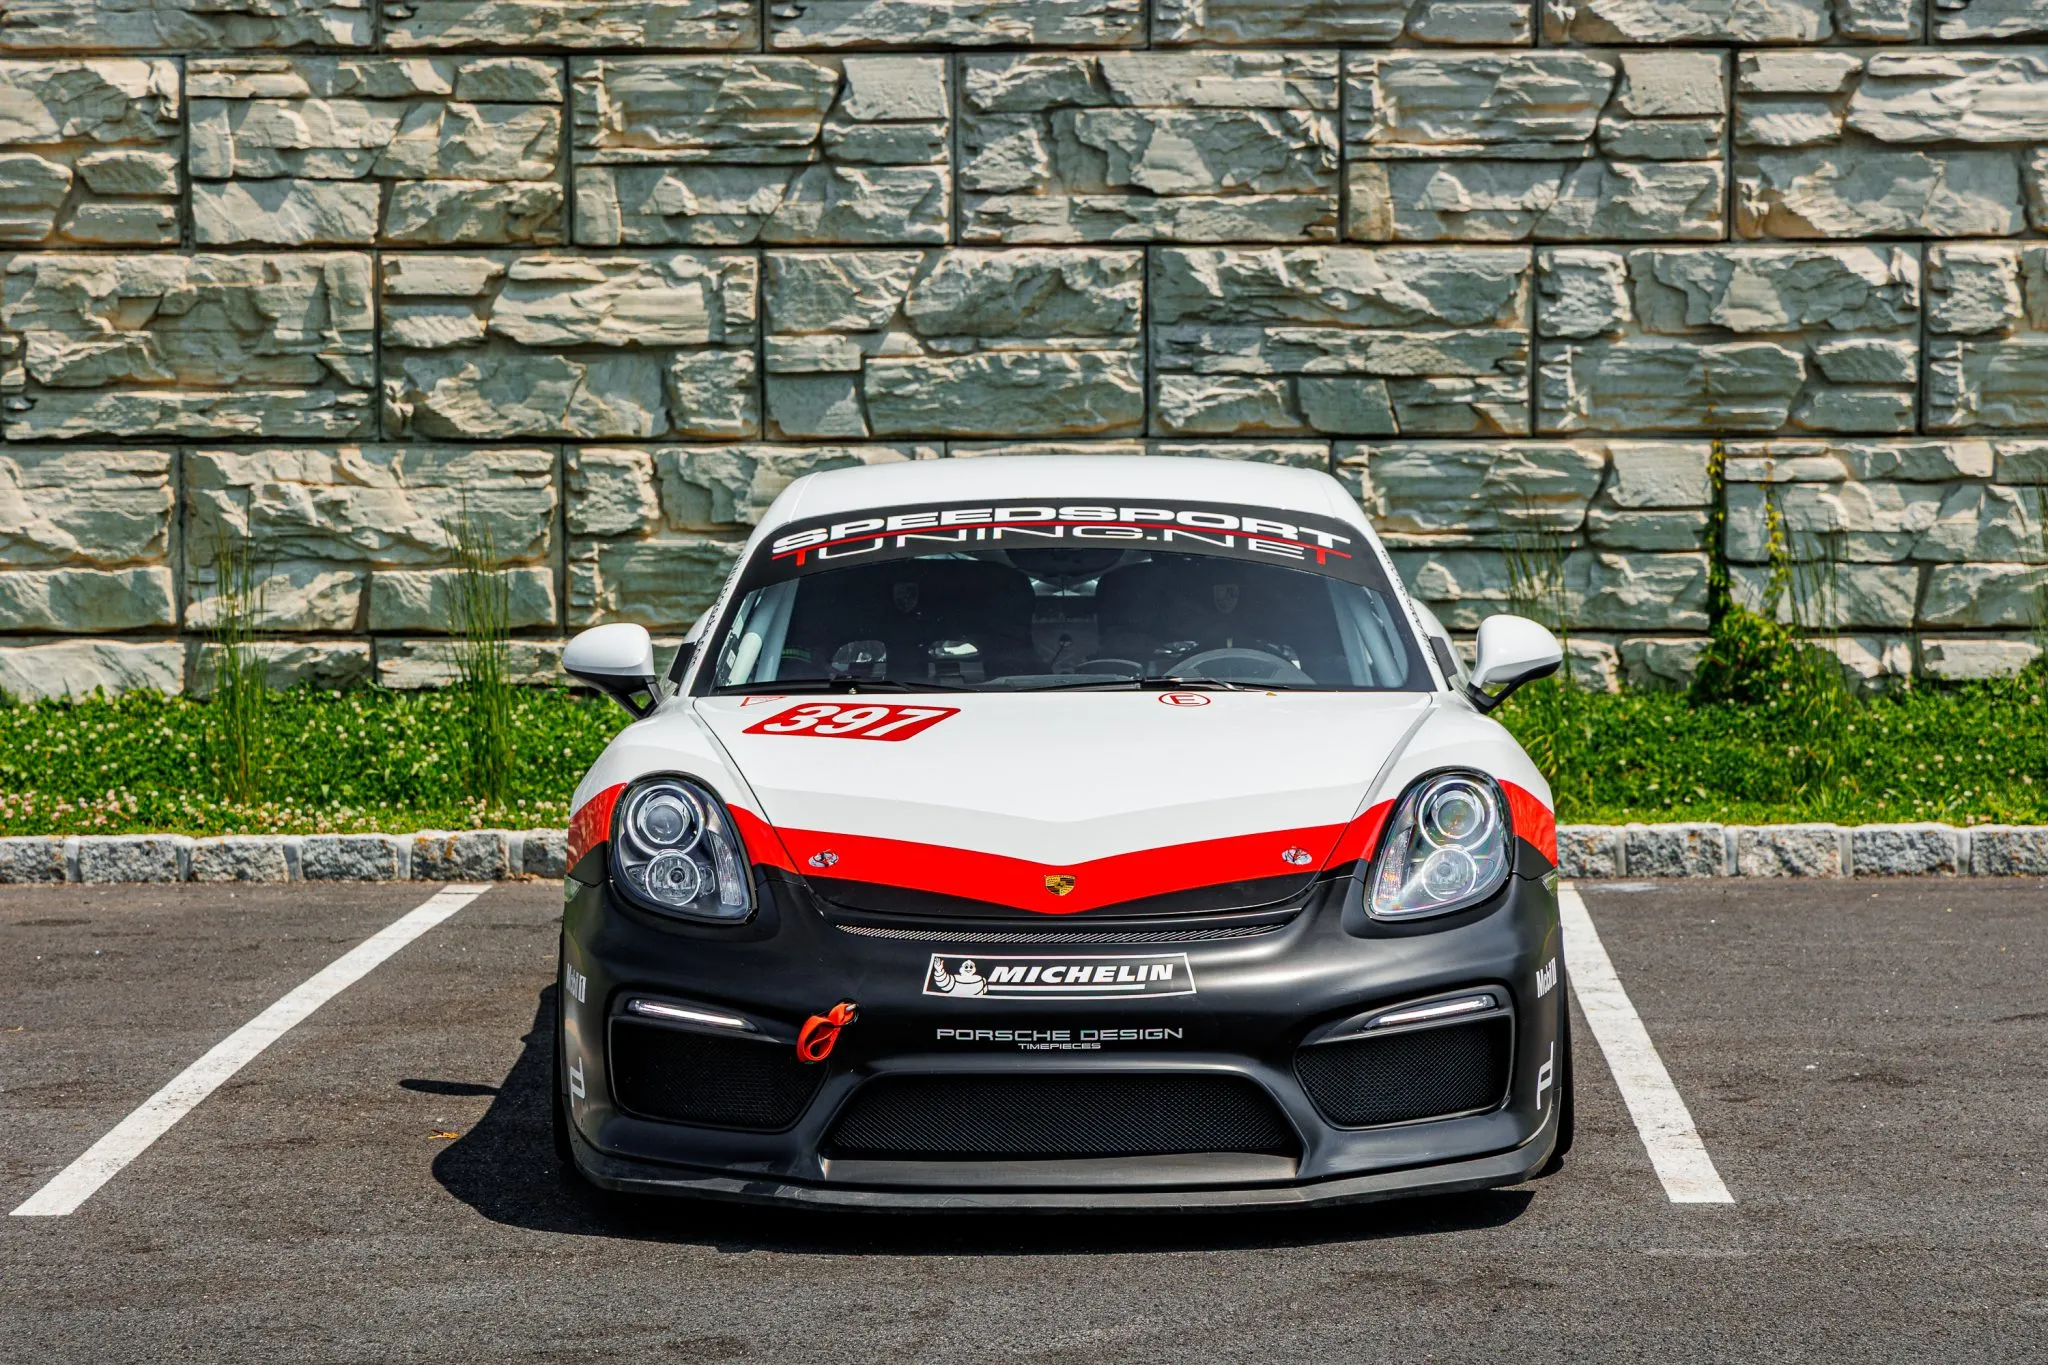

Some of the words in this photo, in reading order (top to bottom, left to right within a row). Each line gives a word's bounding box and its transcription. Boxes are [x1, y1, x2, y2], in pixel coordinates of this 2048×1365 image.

[772, 506, 1352, 554] SPEEDSPORT
[763, 705, 949, 737] 397
[988, 964, 1173, 983] MICHELIN
[937, 1028, 1071, 1041] PORSCHE
[1080, 1028, 1183, 1041] DESIGN
